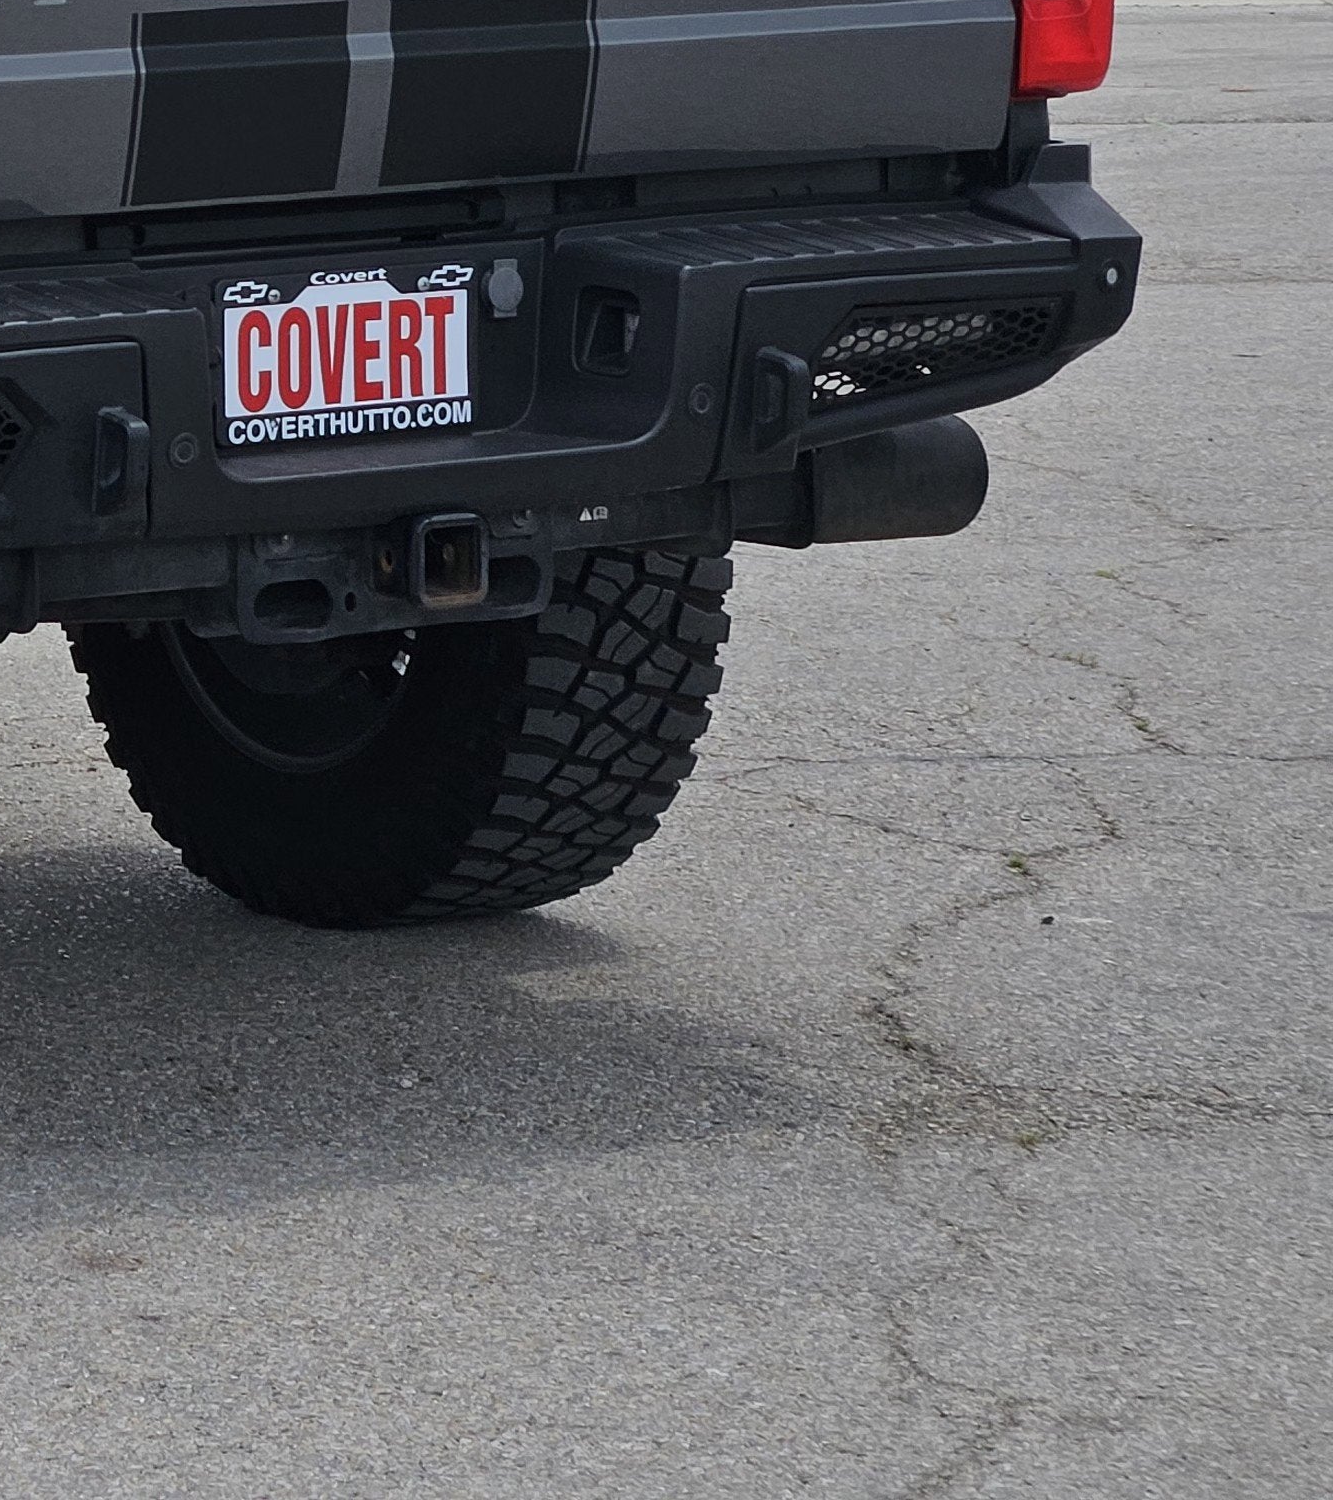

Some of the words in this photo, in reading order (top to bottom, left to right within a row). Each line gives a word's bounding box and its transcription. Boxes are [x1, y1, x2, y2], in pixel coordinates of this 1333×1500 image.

[310, 268, 387, 285] Covert
[238, 296, 454, 413] COVERT
[228, 400, 472, 445] COVERTHUTTO.COM
